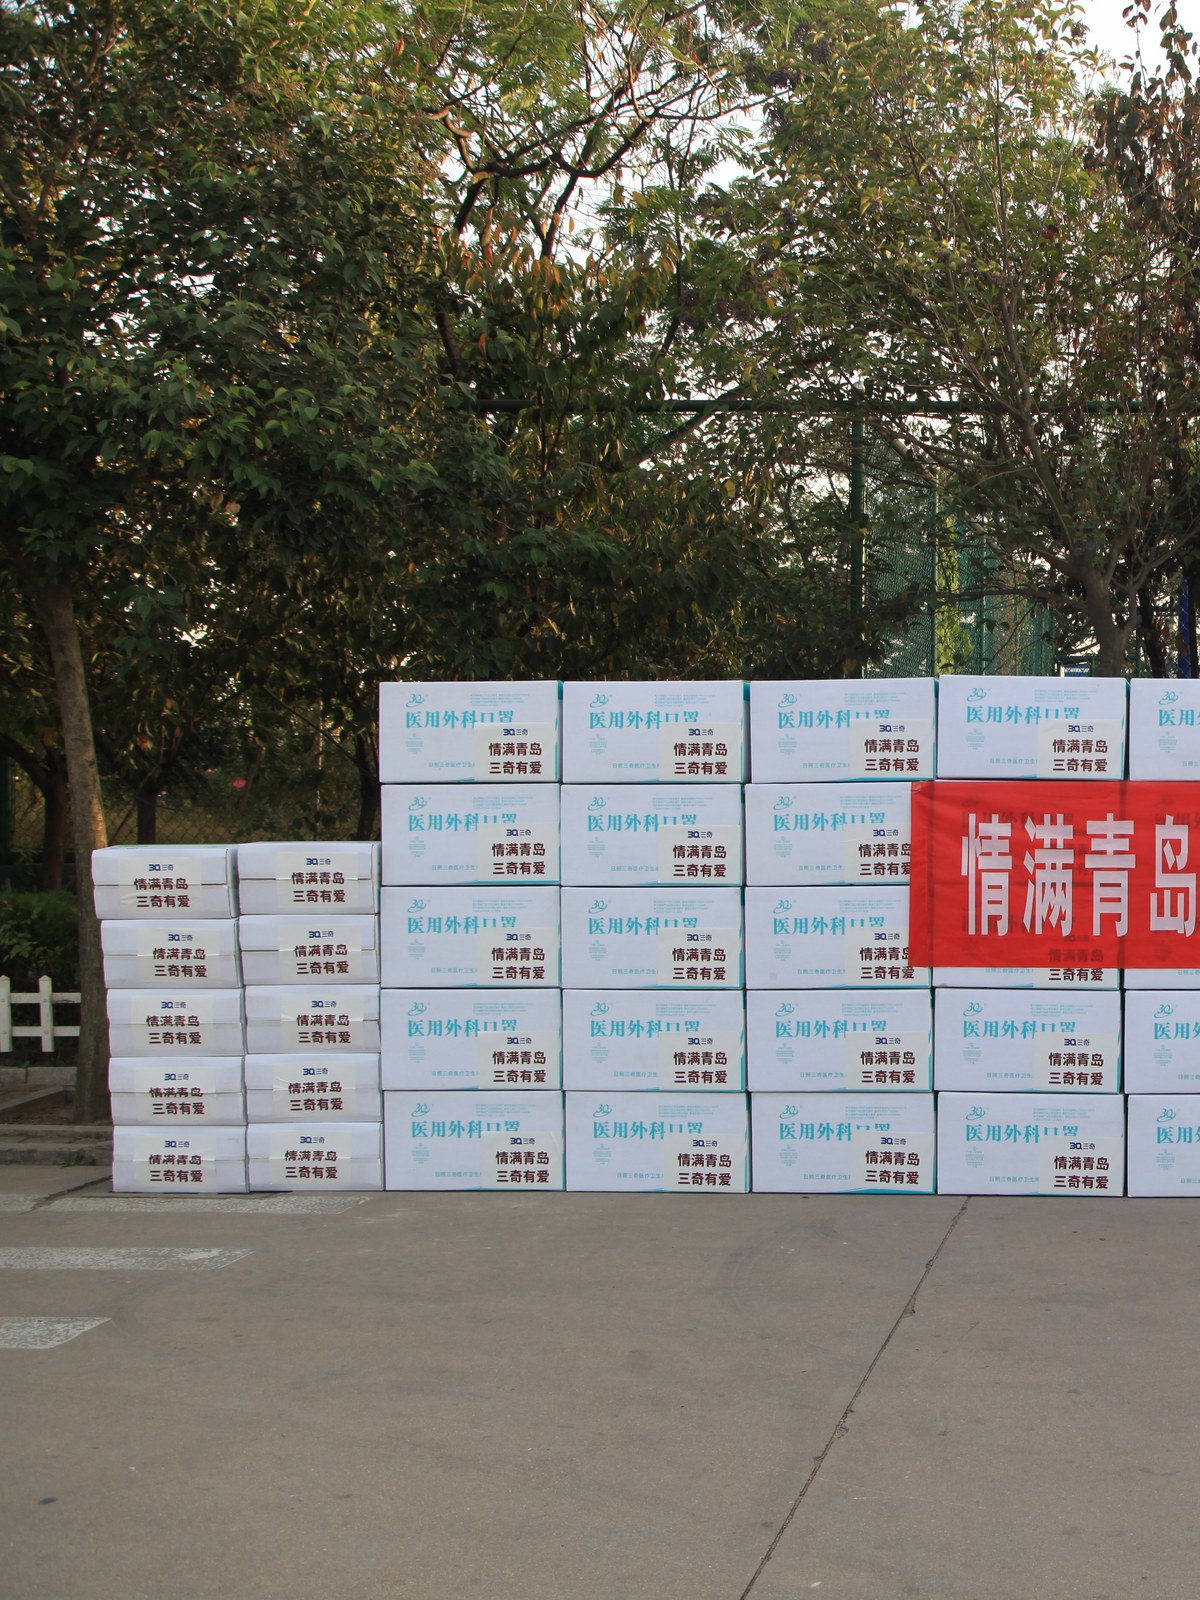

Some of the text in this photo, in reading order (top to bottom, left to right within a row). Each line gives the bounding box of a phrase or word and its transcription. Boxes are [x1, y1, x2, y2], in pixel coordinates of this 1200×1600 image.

[488, 742, 542, 757] 情满青岛
[673, 742, 728, 757] 情满青岛
[864, 738, 920, 753] 情满青岛
[1052, 739, 1108, 754] 情满青岛
[488, 760, 542, 775] 三奇有爱
[674, 760, 728, 775] 三奇有爱
[866, 757, 920, 772] 三奇有爱
[1052, 757, 1108, 773] 三奇有爱
[491, 842, 546, 857] 情满青岛
[672, 844, 727, 859] 情满青岛
[492, 861, 546, 876] 三奇有爱
[673, 863, 727, 878] 三奇有爱
[961, 813, 1197, 937] 情满青岛
[135, 877, 189, 891] 情满青岛
[292, 871, 345, 885] 情满青岛
[137, 894, 191, 908] 三奇有爱
[292, 889, 346, 903] 三奇有爱
[154, 947, 206, 961] 情满青岛
[295, 943, 348, 958] 情满青岛
[491, 947, 546, 961] 情满青岛
[672, 947, 727, 962] 情满青岛
[154, 963, 208, 978] 三奇有爱
[296, 960, 350, 975] 三奇有爱
[491, 965, 545, 980] 三奇有爱
[672, 966, 726, 981] 三奇有爱
[860, 965, 915, 980] 三奇有爱
[1048, 968, 1104, 982] 三奇有爱
[146, 1015, 200, 1028] 情满青岛
[297, 1014, 350, 1027] 情满青岛
[148, 1031, 202, 1045] 三奇有爱
[298, 1030, 352, 1044] 三奇有爱
[492, 1050, 546, 1065] 情满青岛
[674, 1051, 728, 1066] 情满青岛
[860, 1050, 916, 1065] 情满青岛
[1049, 1052, 1104, 1067] 情满青岛
[493, 1069, 547, 1083] 三奇有爱
[673, 1069, 728, 1084] 三奇有爱
[862, 1069, 916, 1084] 三奇有爱
[1048, 1071, 1104, 1086] 三奇有爱
[150, 1087, 205, 1098] 情满青岛
[289, 1080, 343, 1095] 情满青岛
[151, 1101, 205, 1115] 三奇有爱
[290, 1097, 344, 1112] 三奇有爱
[149, 1154, 202, 1166] 情满青岛
[286, 1150, 338, 1162] 情满青岛
[497, 1151, 550, 1165] 情满青岛
[677, 1153, 732, 1168] 情满青岛
[865, 1150, 920, 1165] 情满青岛
[1054, 1155, 1110, 1171] 情满青岛
[149, 1169, 203, 1183] 三奇有爱
[284, 1165, 338, 1180] 三奇有爱
[496, 1169, 550, 1183] 三奇有爱
[678, 1171, 732, 1186] 三奇有爱
[865, 1169, 920, 1185] 三奇有爱
[1055, 1174, 1109, 1190] 三奇有爱
